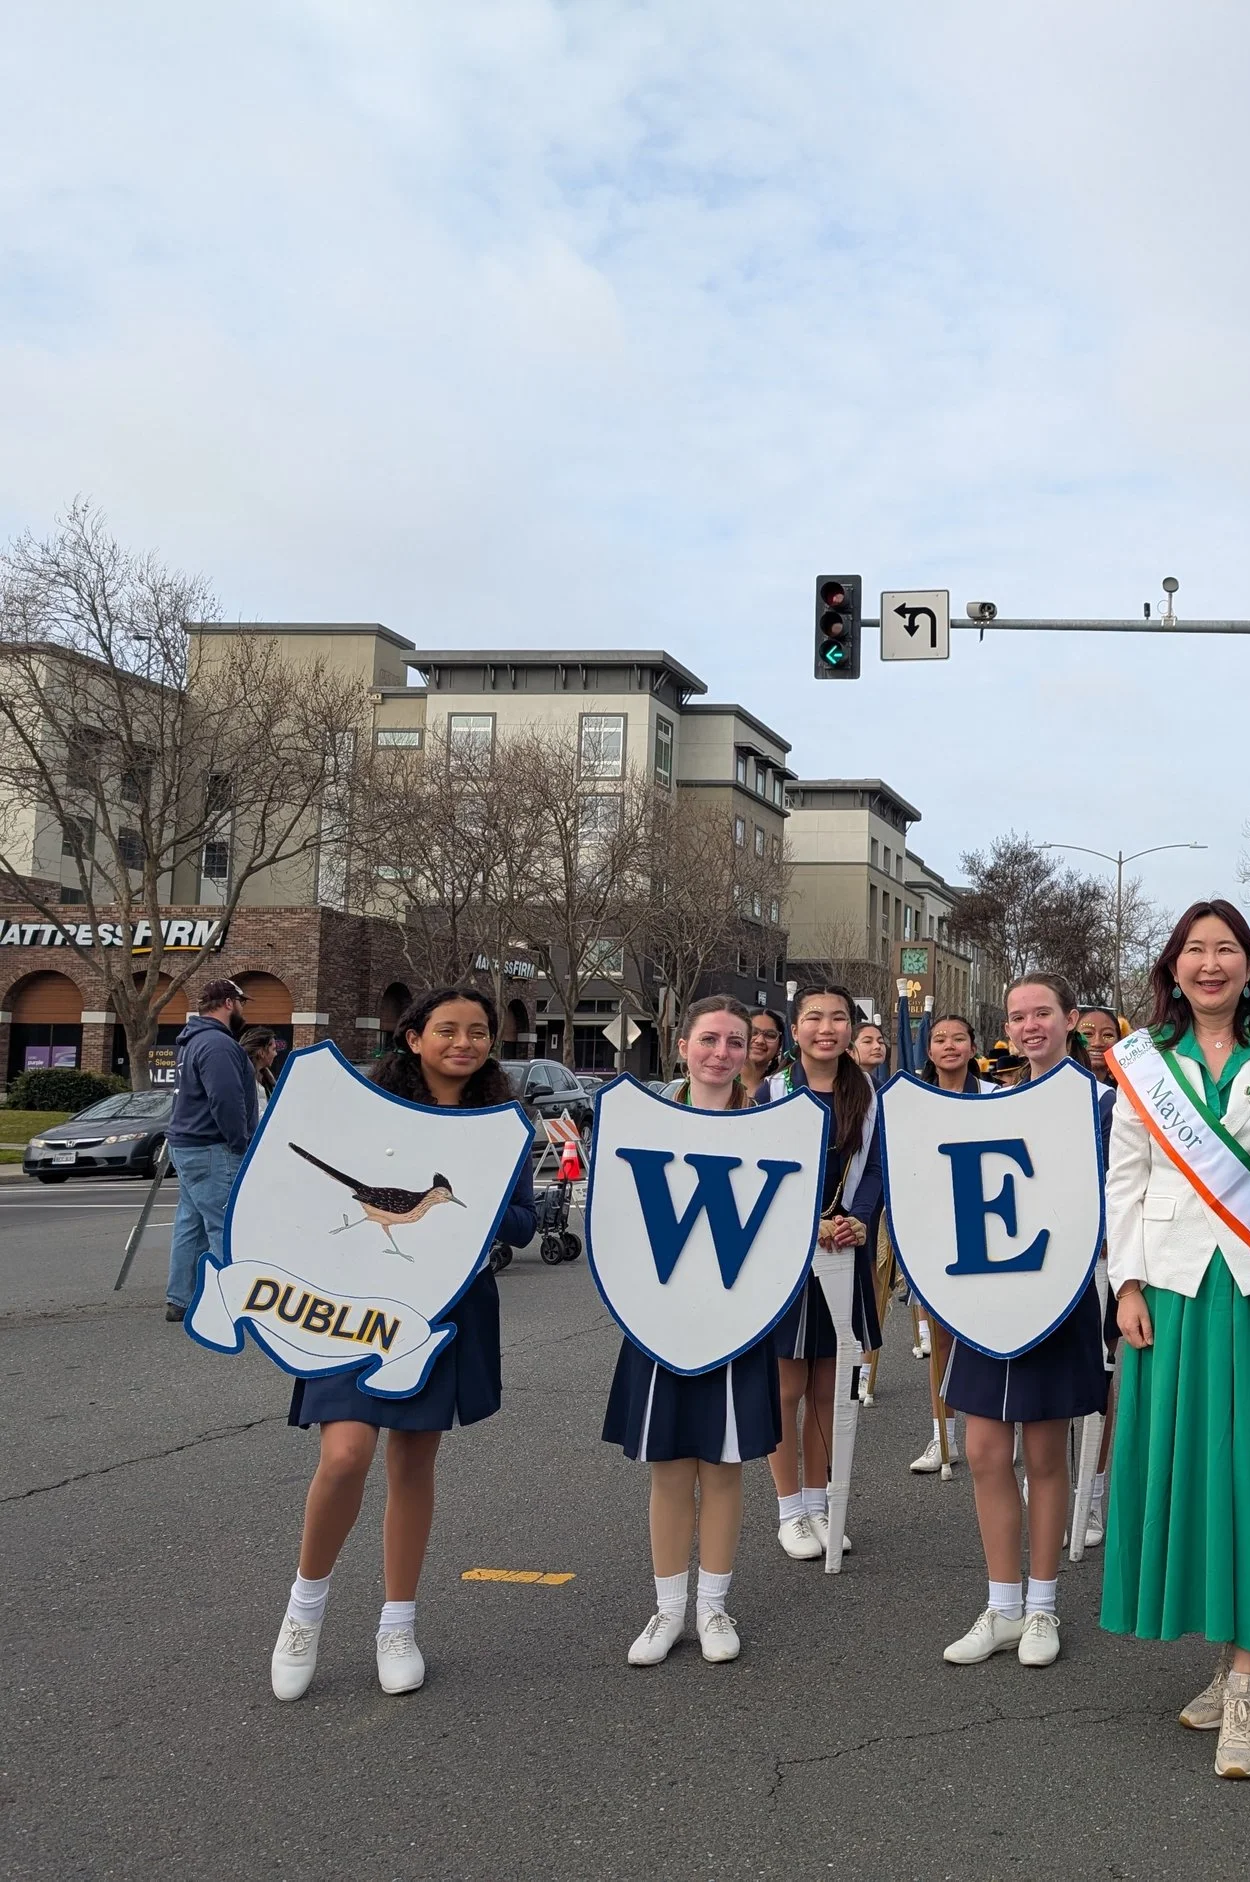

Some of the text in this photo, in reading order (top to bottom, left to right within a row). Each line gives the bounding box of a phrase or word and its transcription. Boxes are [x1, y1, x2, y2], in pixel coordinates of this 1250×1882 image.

[148, 1049, 174, 1058] grade
[155, 1058, 176, 1067] Sleep
[1119, 1037, 1153, 1067] DUBLIN
[1147, 1076, 1203, 1150] Mayor
[615, 1147, 802, 1290] W
[938, 1138, 1050, 1275] E
[243, 1277, 402, 1354] DUBLIN
